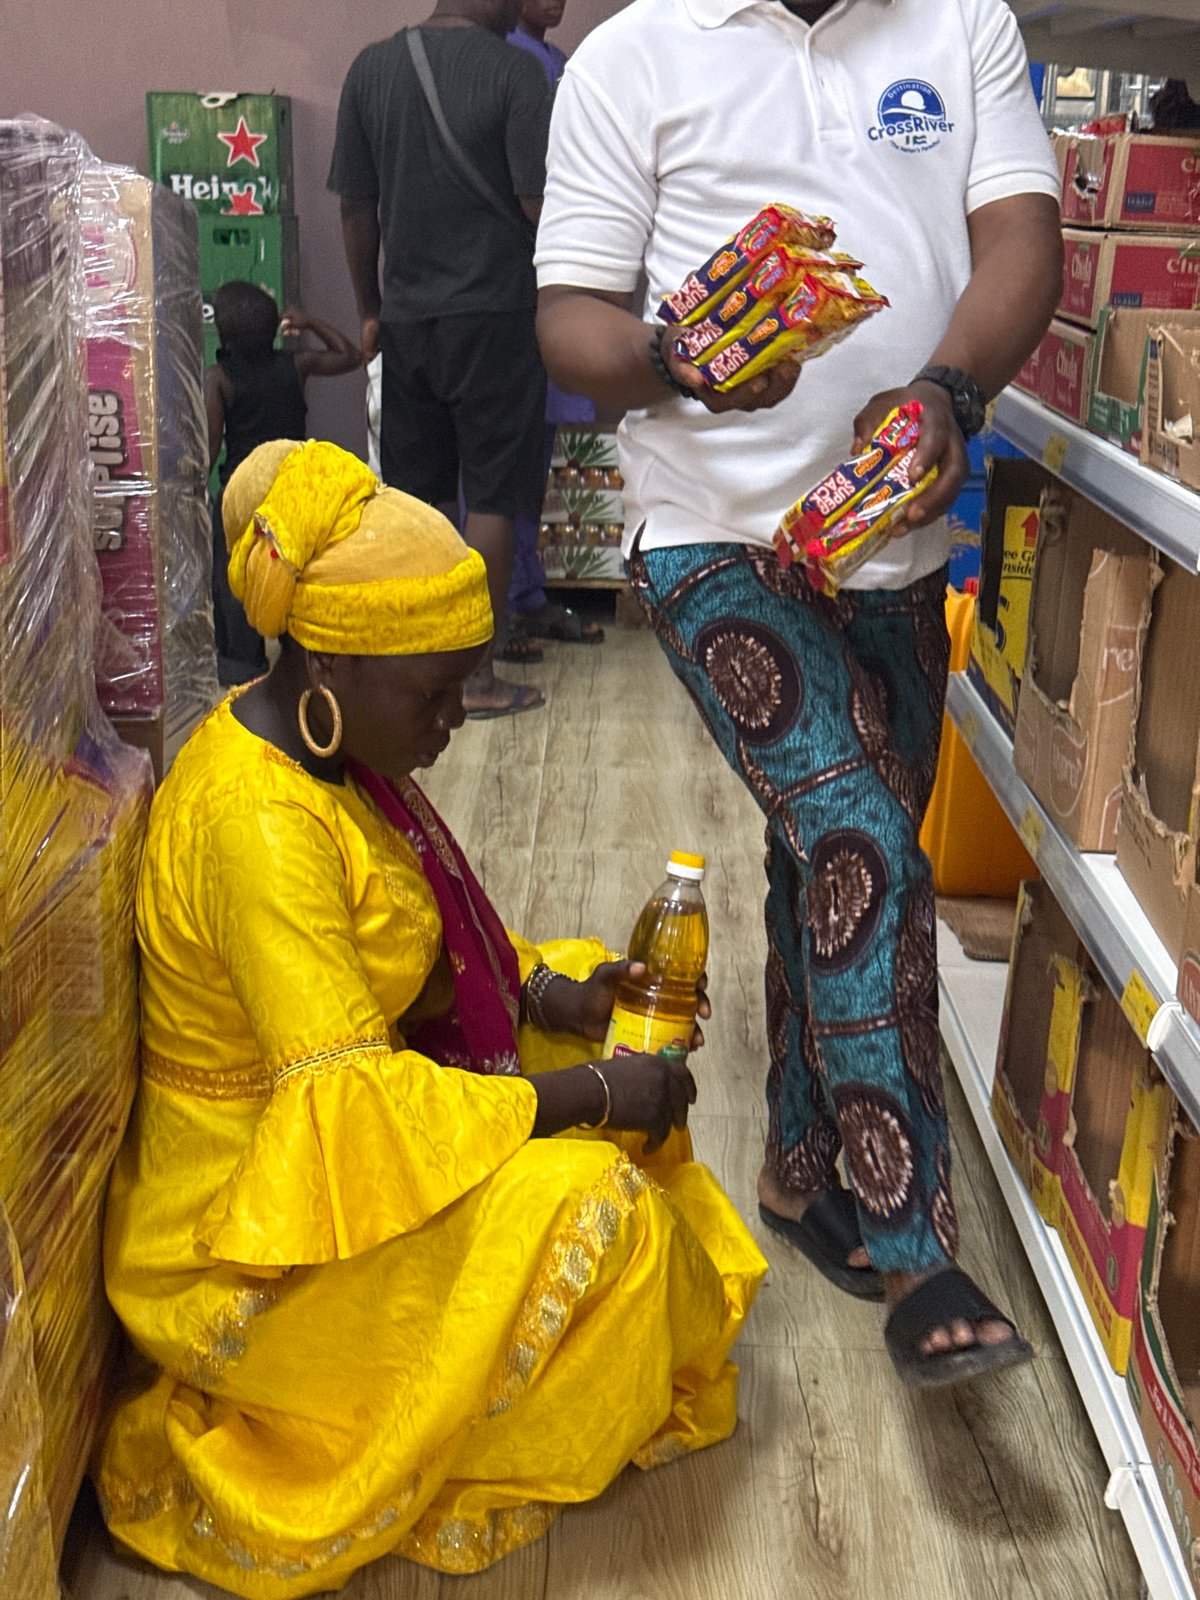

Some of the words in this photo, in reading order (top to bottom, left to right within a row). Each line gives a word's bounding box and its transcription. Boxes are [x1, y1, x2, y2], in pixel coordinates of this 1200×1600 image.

[867, 115, 955, 141] CrossRiver
[689, 322, 723, 358] SUPER
[714, 347, 750, 382] SUPER
[809, 470, 847, 507] PACK
[818, 480, 856, 516] SUPER
